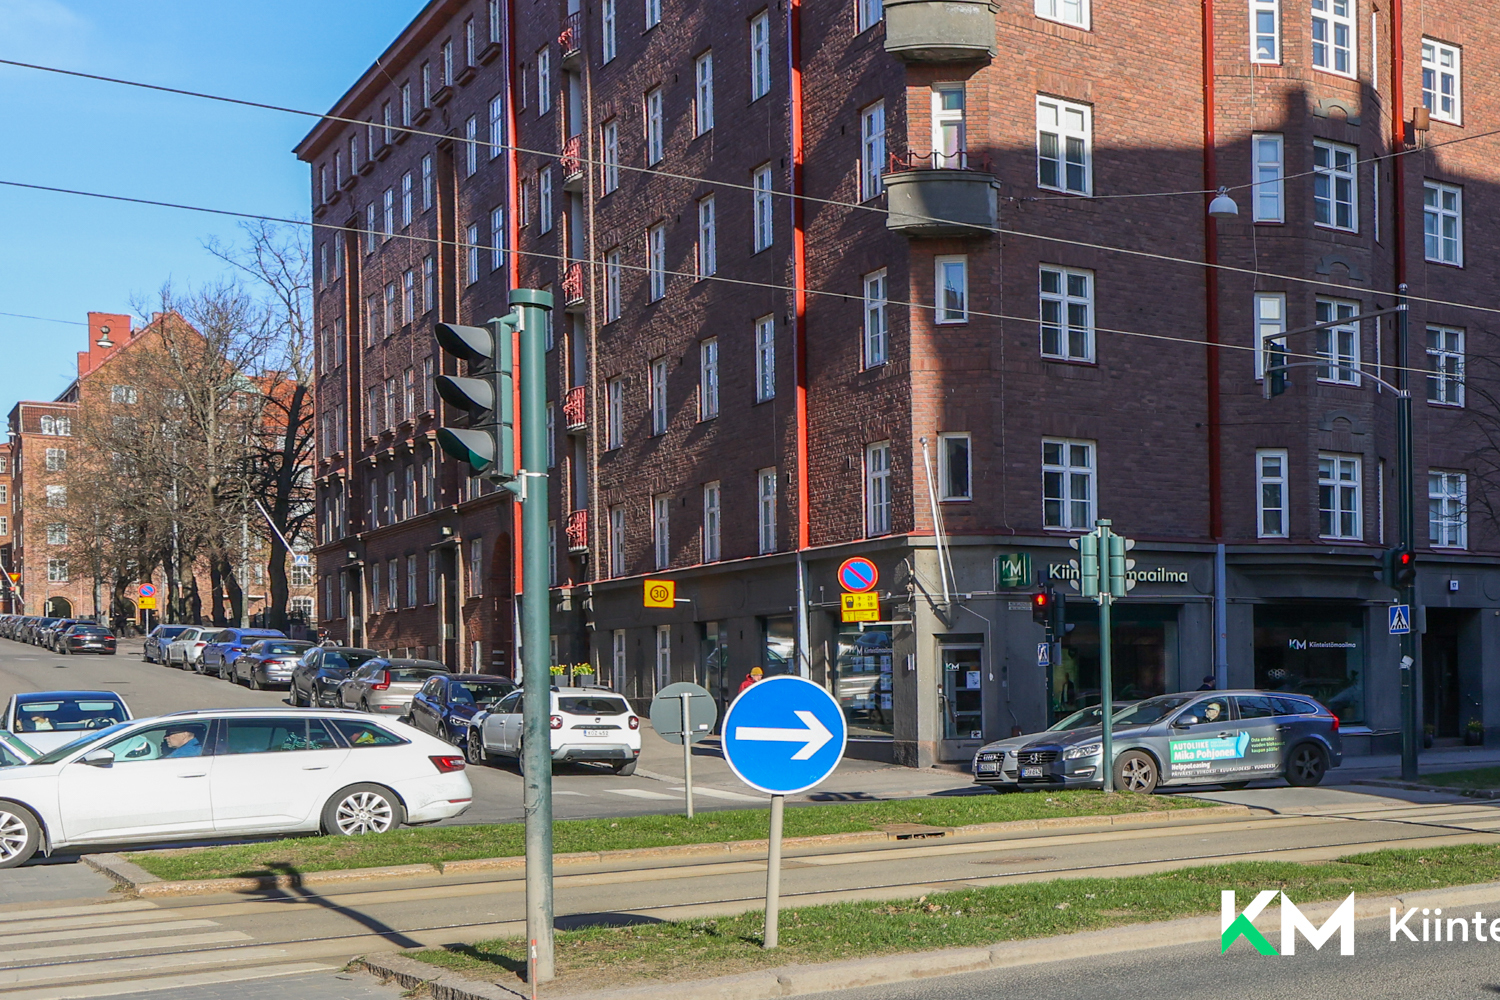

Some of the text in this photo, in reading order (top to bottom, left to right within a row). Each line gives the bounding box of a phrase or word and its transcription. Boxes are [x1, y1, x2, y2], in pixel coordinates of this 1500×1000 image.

[1002, 559, 1022, 577] KM
[1049, 563, 1188, 582] Kiinimaailma
[653, 589, 665, 599] 30
[1289, 638, 1307, 650] KM
[945, 662, 960, 670] KM
[1173, 741, 1209, 751] AUTOLIIKE
[1174, 748, 1235, 761] Mika Pohjonen
